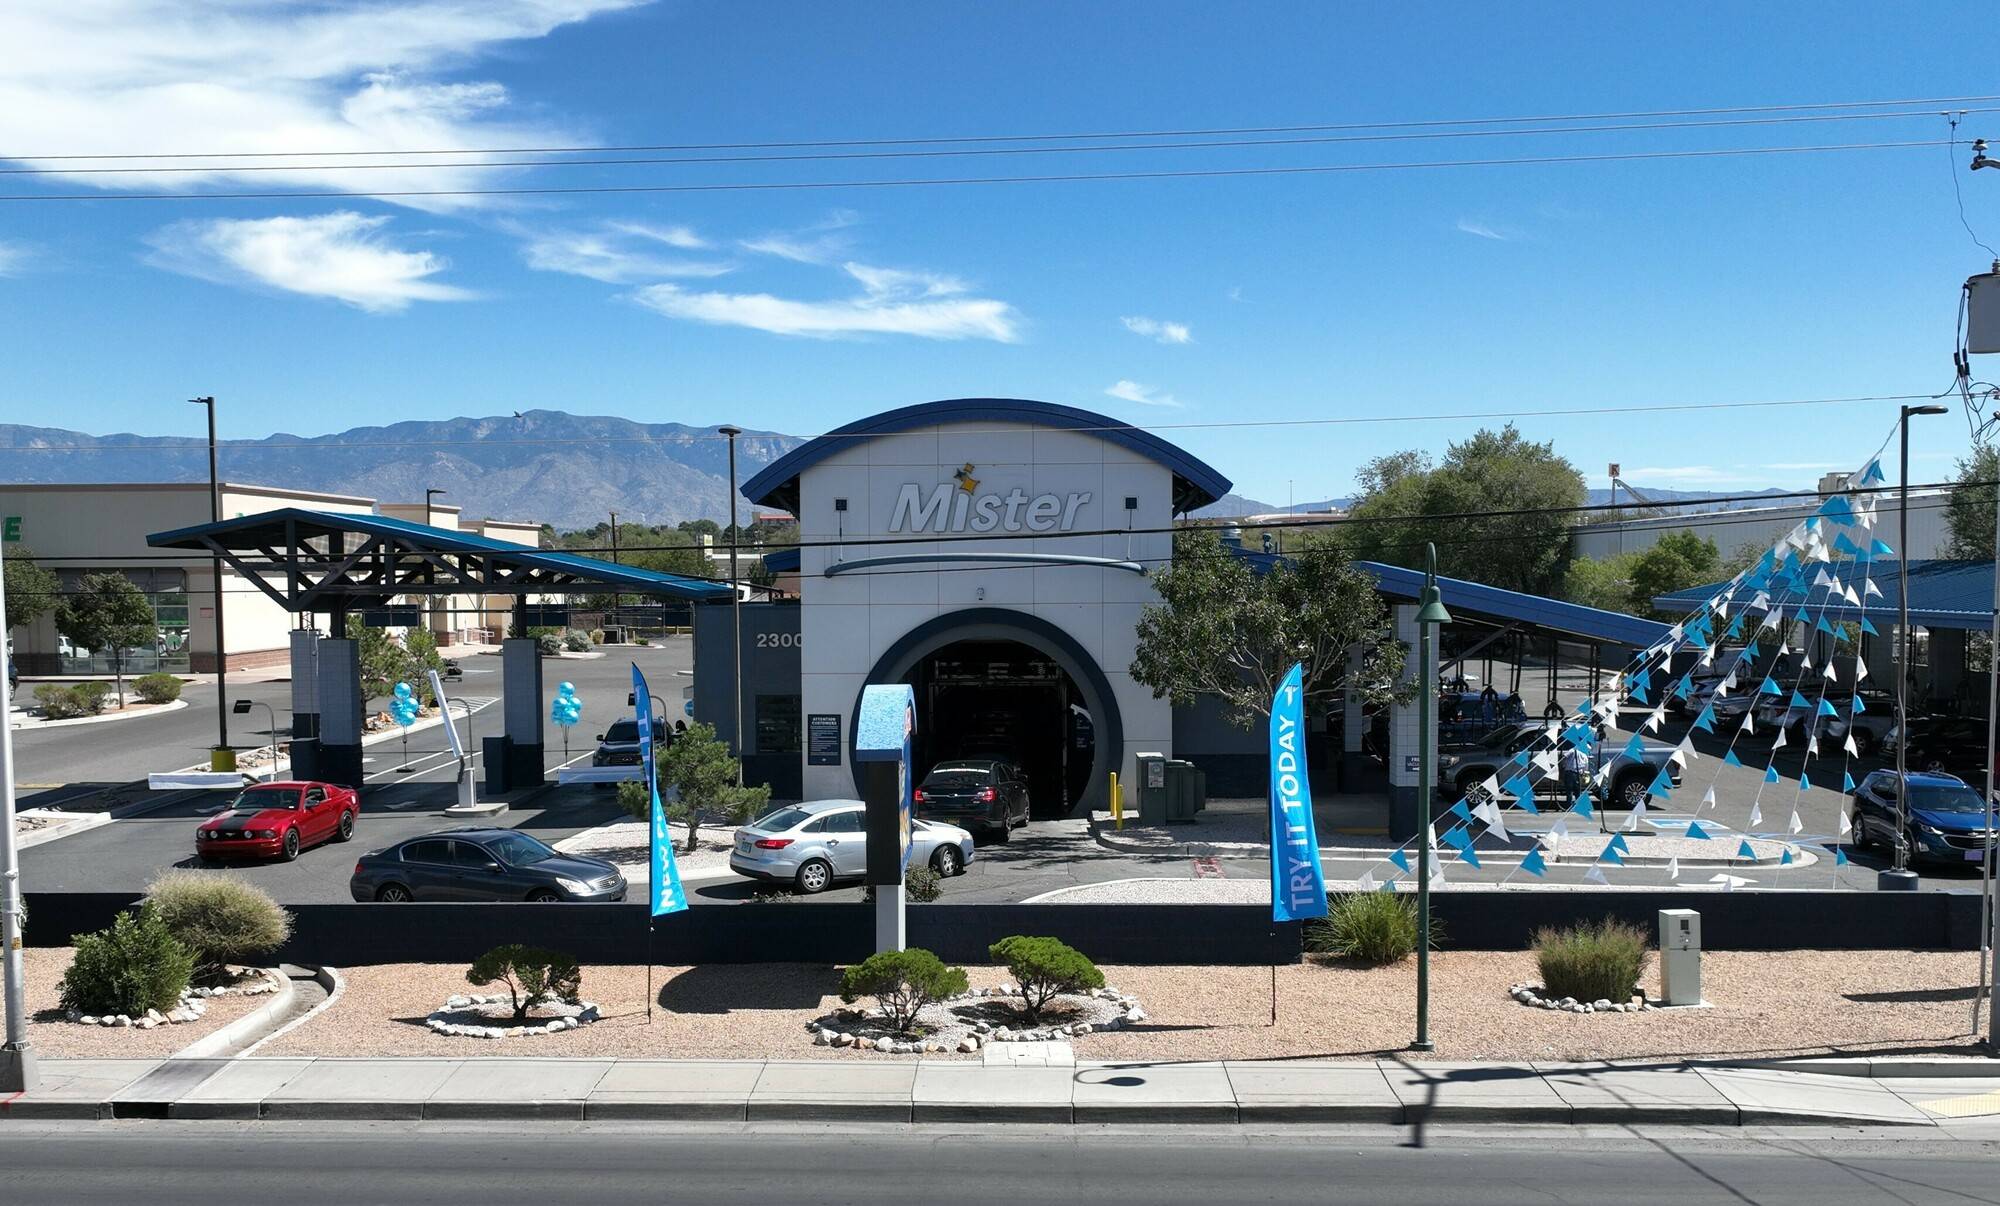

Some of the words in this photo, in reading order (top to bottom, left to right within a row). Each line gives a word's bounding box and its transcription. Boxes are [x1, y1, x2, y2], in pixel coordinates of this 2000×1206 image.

[887, 480, 1093, 533] Mister
[756, 633, 802, 648] 2300
[1277, 714, 1303, 814] TODAY
[1286, 821, 1309, 847] IT
[1288, 856, 1315, 912] TRY
